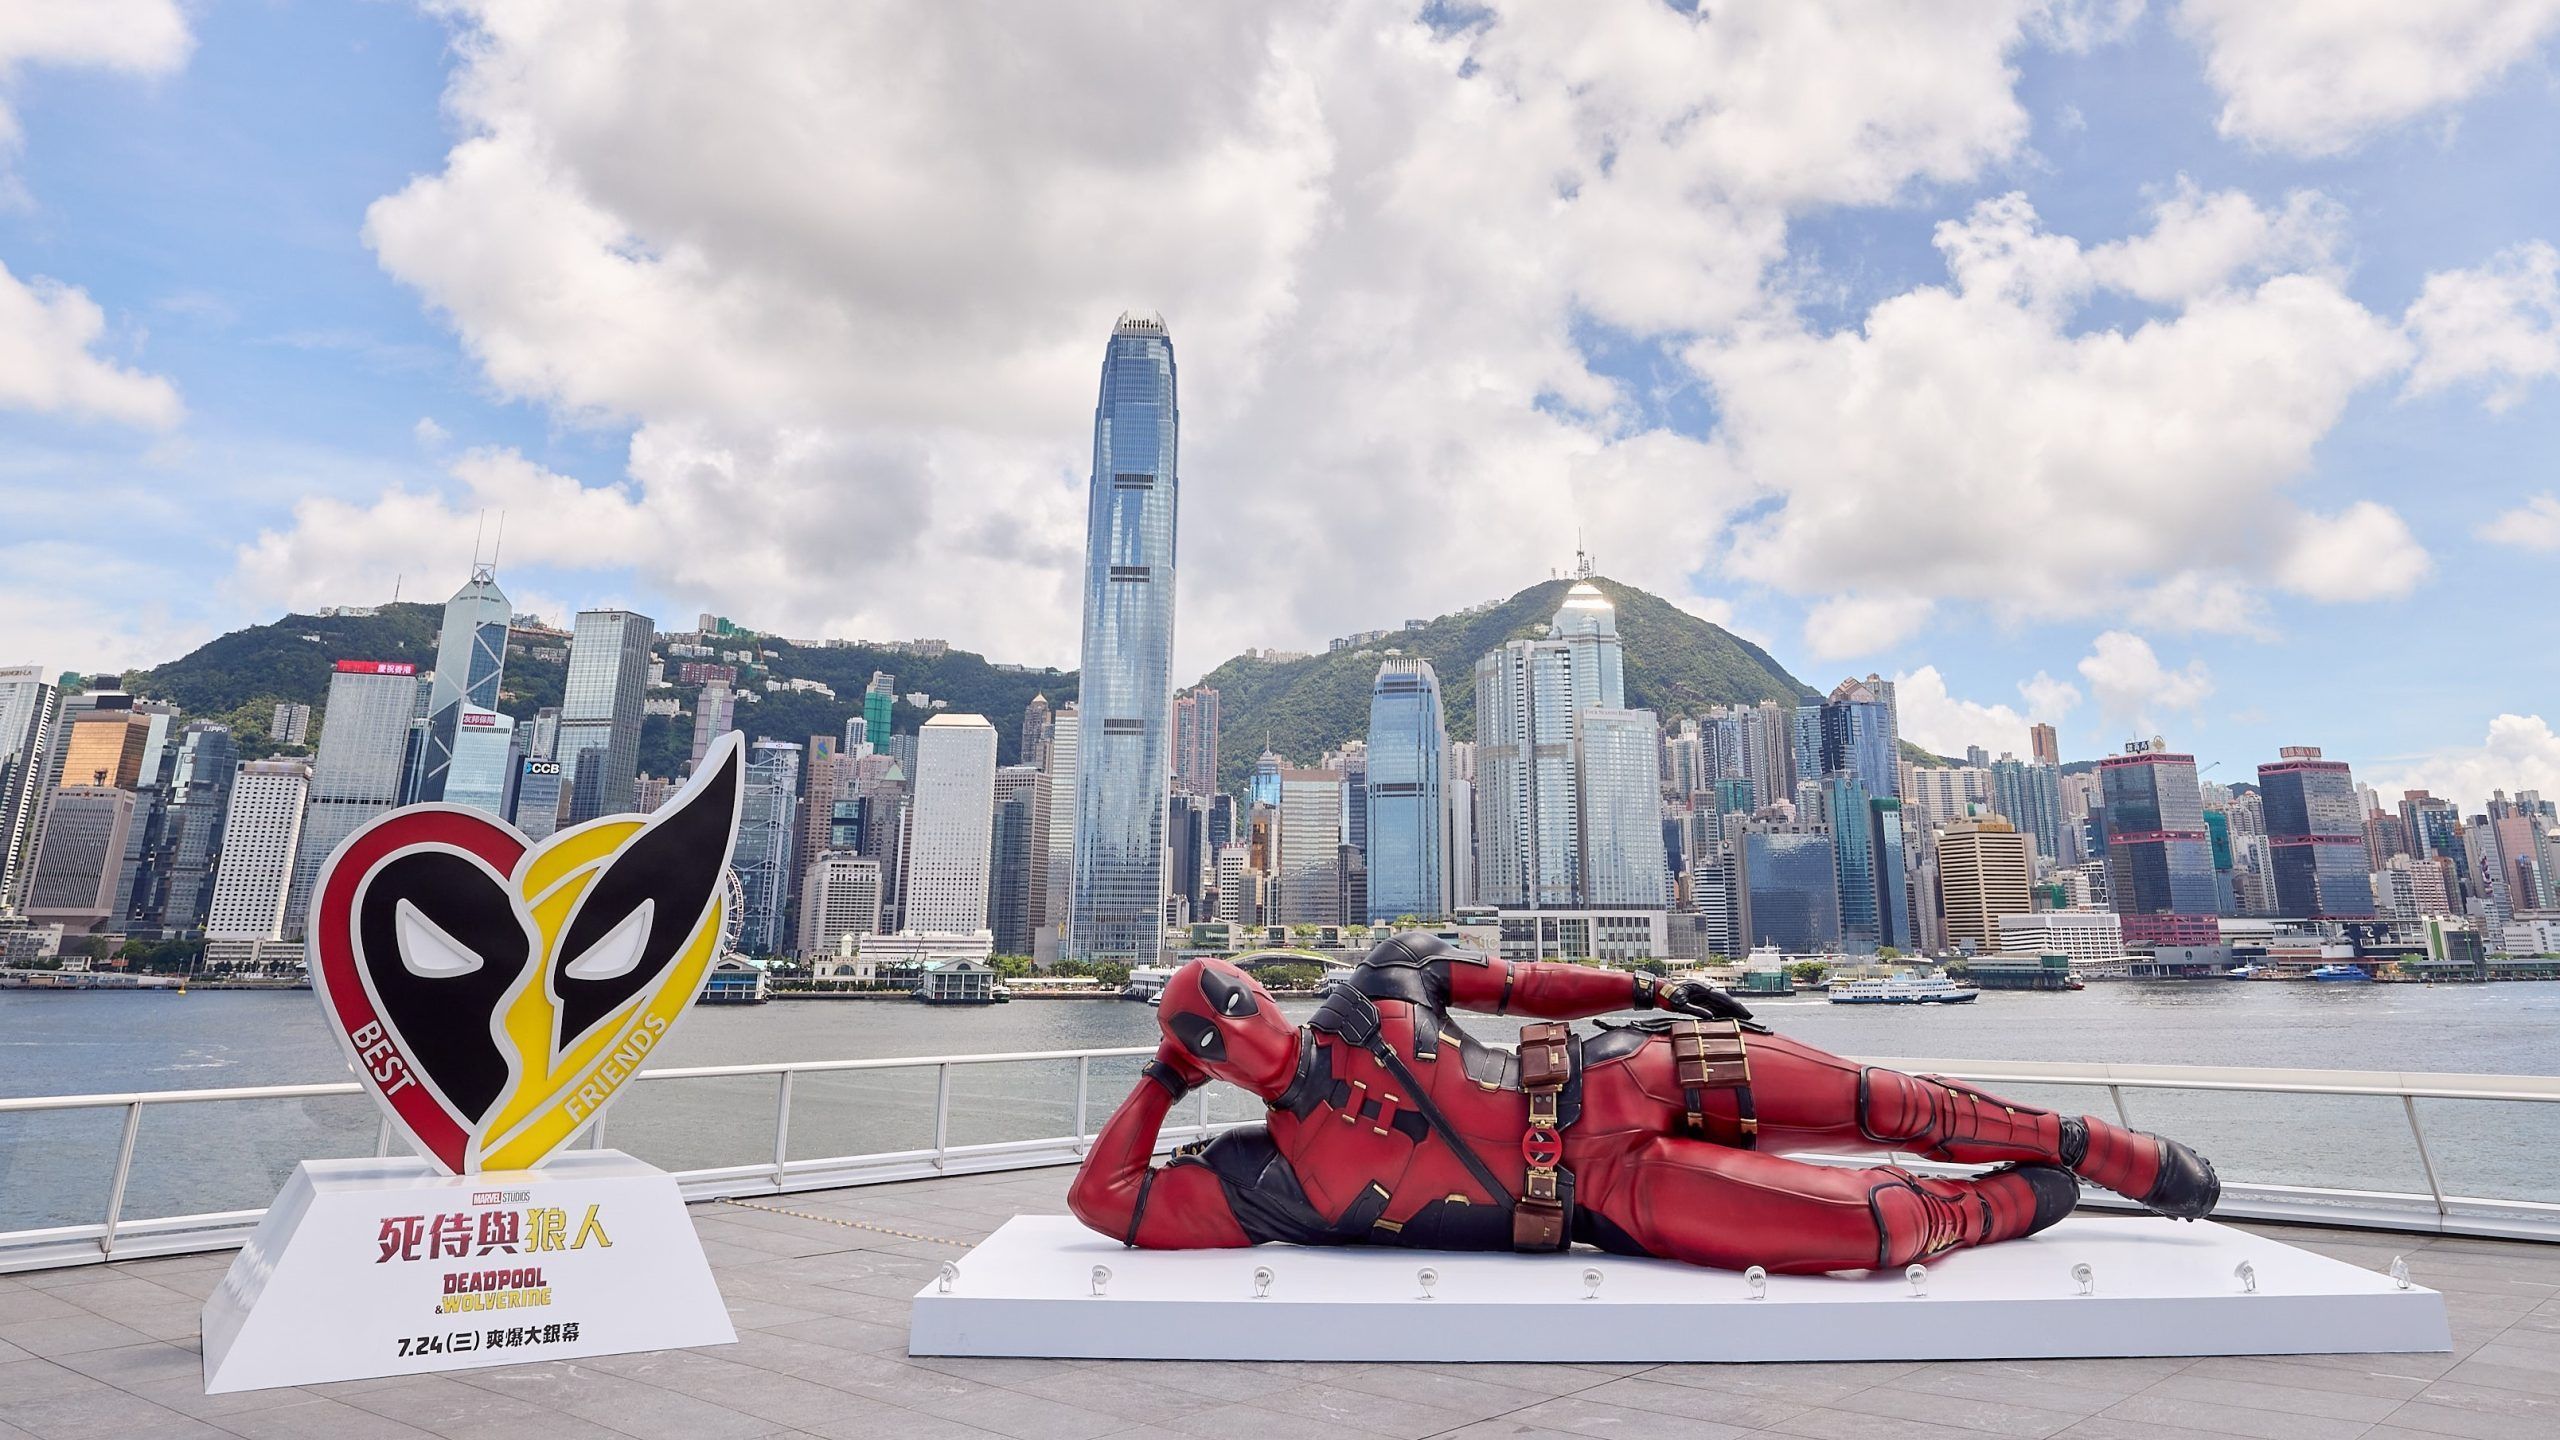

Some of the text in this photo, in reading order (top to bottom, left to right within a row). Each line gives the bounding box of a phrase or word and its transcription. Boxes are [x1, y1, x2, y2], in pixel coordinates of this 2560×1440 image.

[203, 725, 228, 733] LIPPO
[532, 763, 560, 774] CCB
[351, 1019, 417, 1096] BEST
[564, 1012, 667, 1123] FRIENDS
[473, 1191, 531, 1205] MARVEL STUDIOS
[376, 1204, 613, 1263] 死侍與狼人
[443, 1267, 547, 1294] DEADPOOL
[486, 1322, 580, 1349] 爽爆大銀幕
